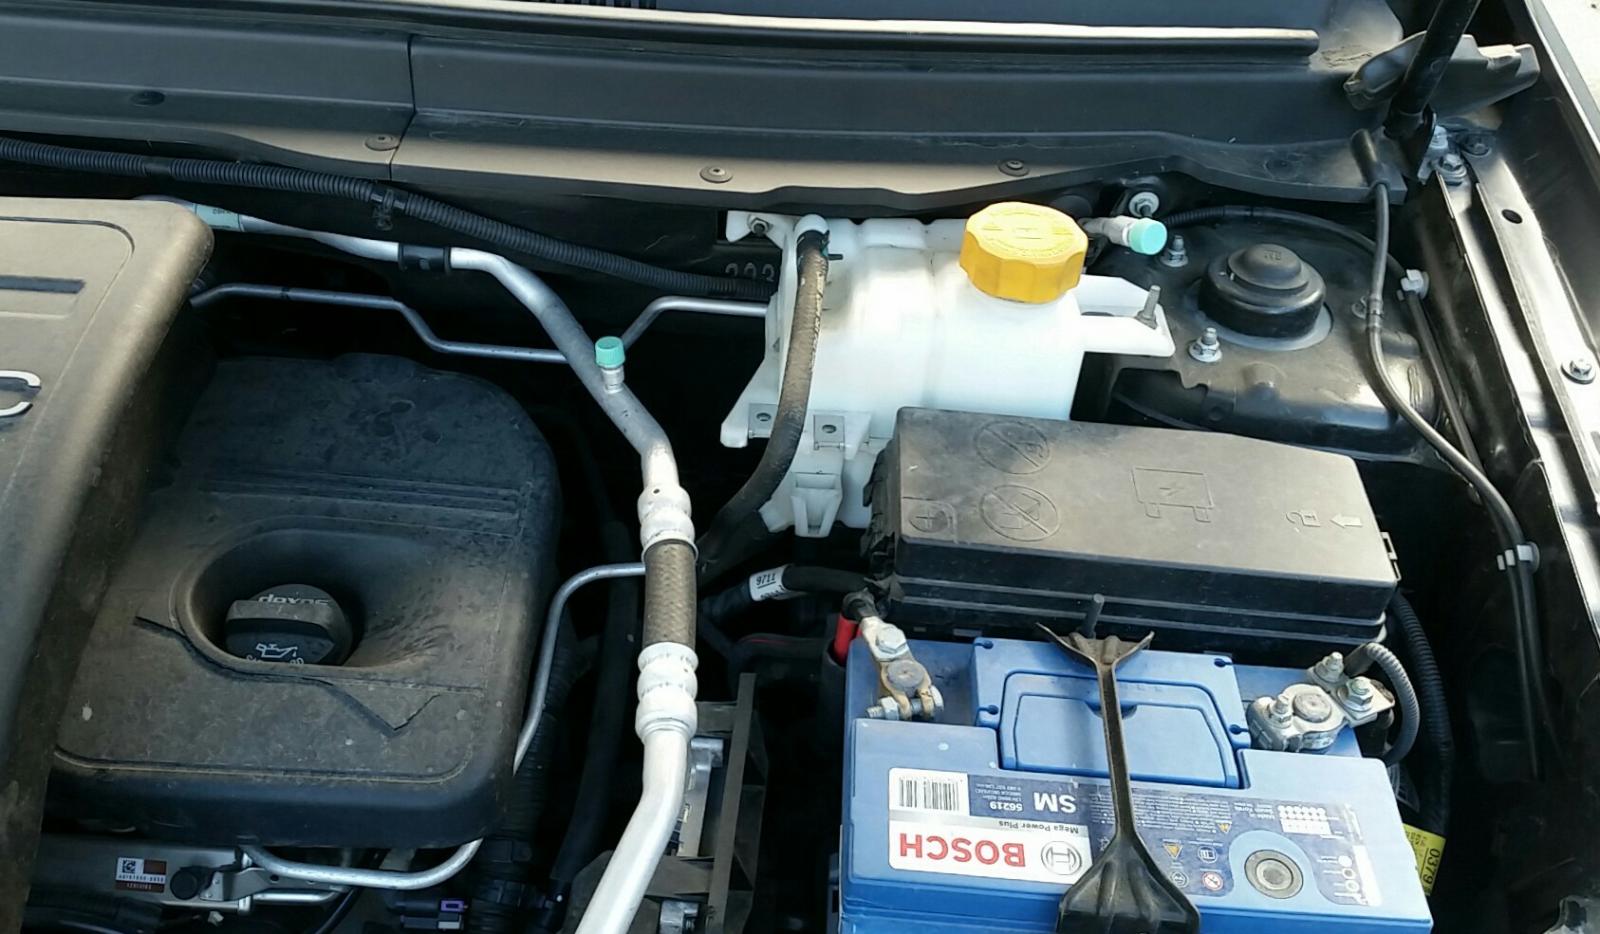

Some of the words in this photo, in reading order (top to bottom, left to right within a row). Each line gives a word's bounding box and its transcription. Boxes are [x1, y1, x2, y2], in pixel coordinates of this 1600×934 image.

[989, 801, 1023, 813] 56219
[1033, 791, 1076, 813] SM
[998, 820, 1019, 830] Plus
[1022, 822, 1051, 831] Power
[1053, 824, 1079, 834] Mega
[899, 833, 1026, 867] BOSCH
[1423, 848, 1441, 885] 0379
